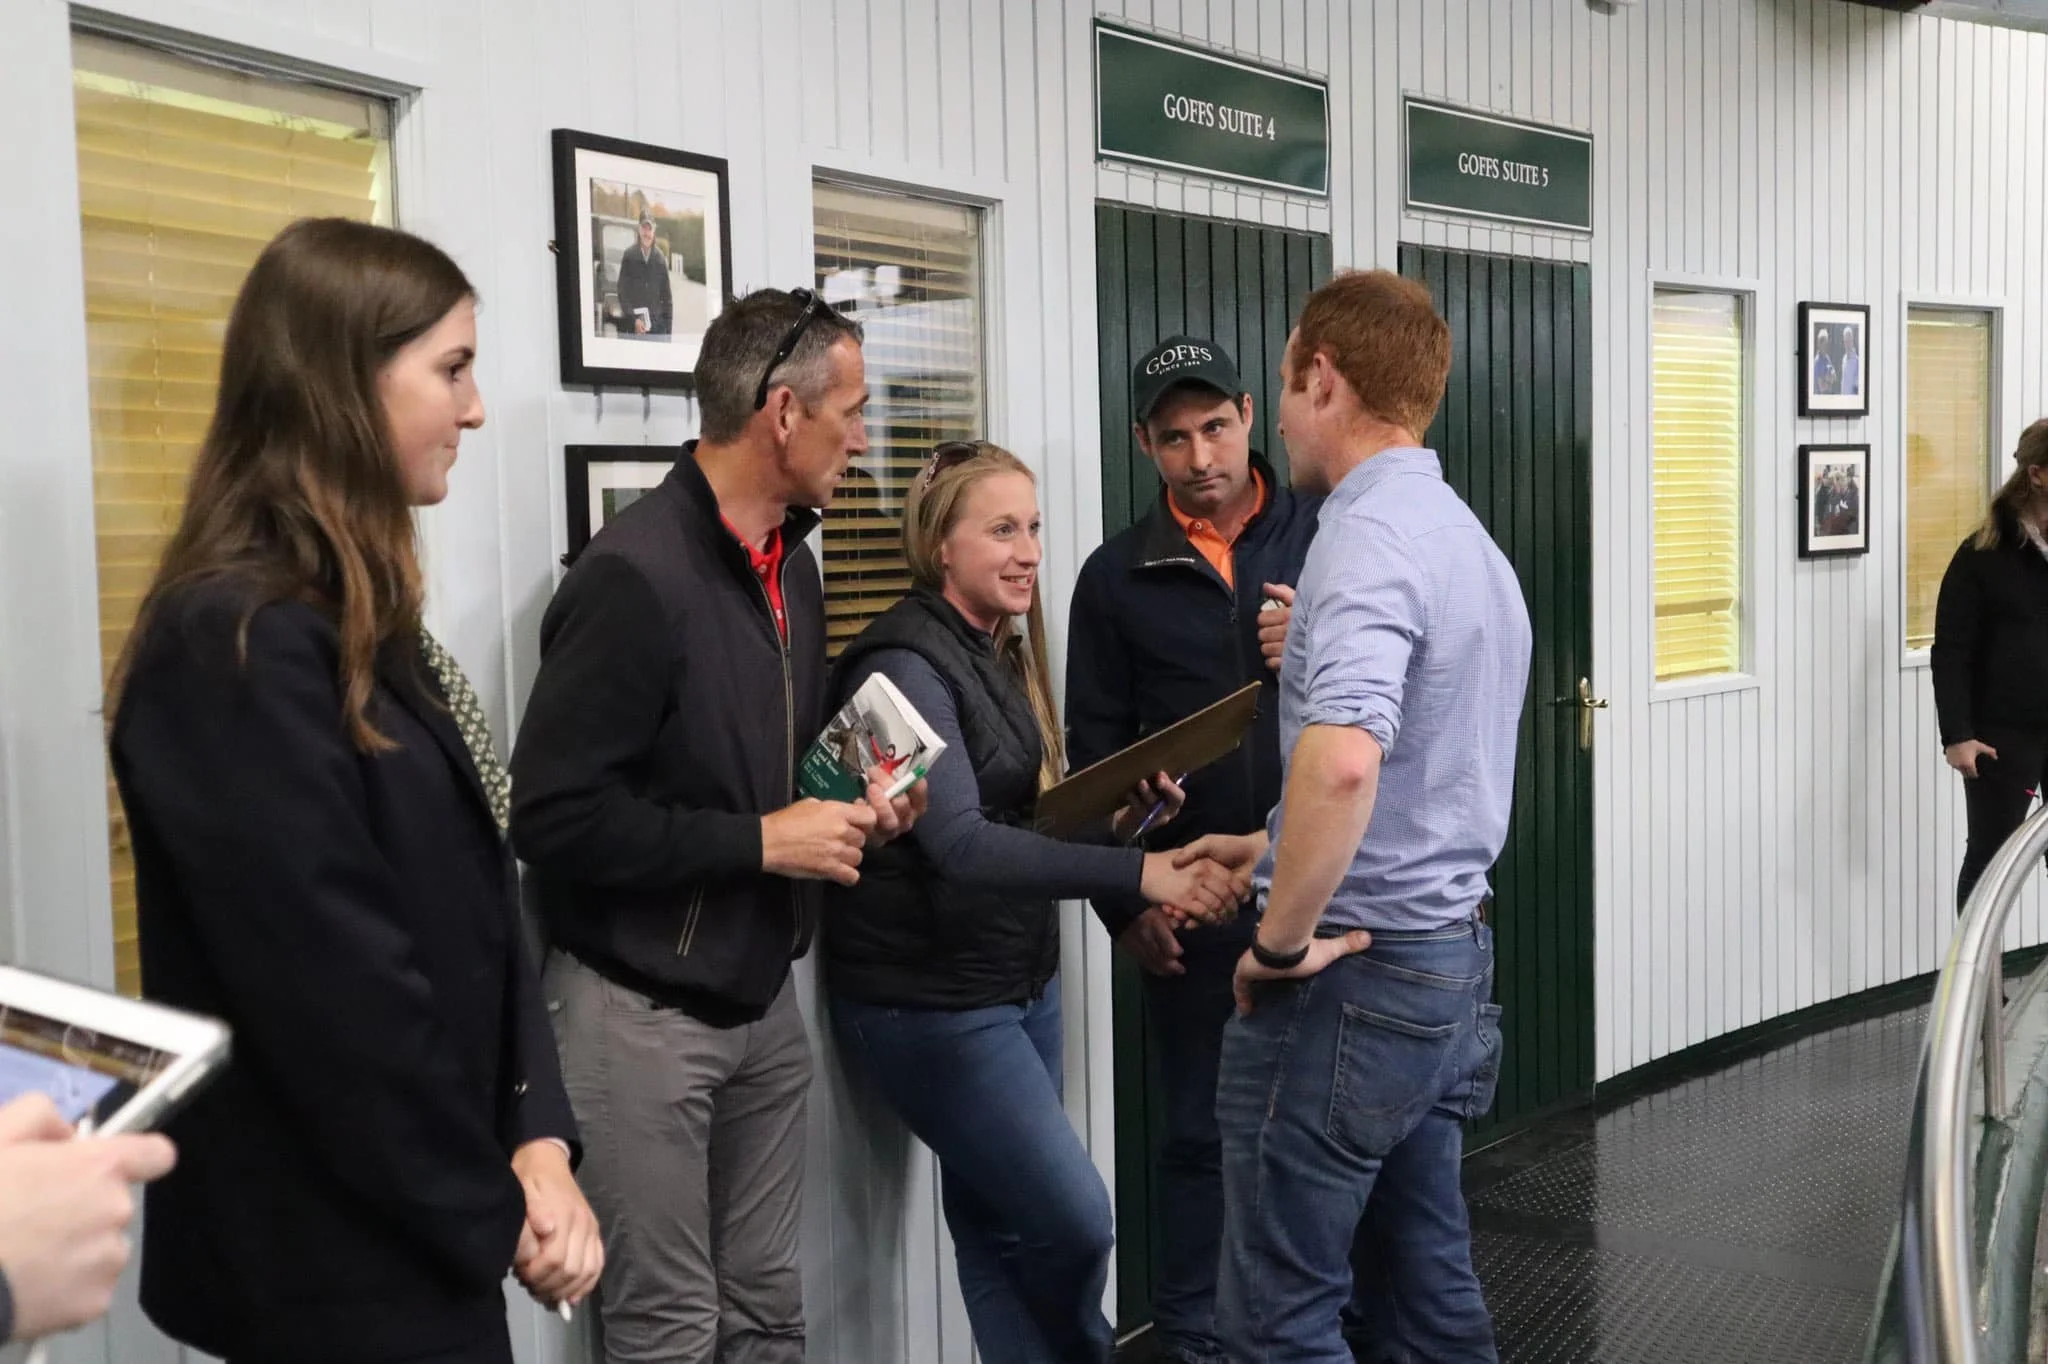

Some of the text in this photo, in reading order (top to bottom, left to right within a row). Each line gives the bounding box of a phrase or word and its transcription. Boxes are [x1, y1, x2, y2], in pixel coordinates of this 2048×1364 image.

[1163, 93, 1276, 141] GOFFS SUITE 4
[1458, 152, 1549, 187] GOFFS SUITE 5
[1146, 344, 1212, 375] GOFFS
